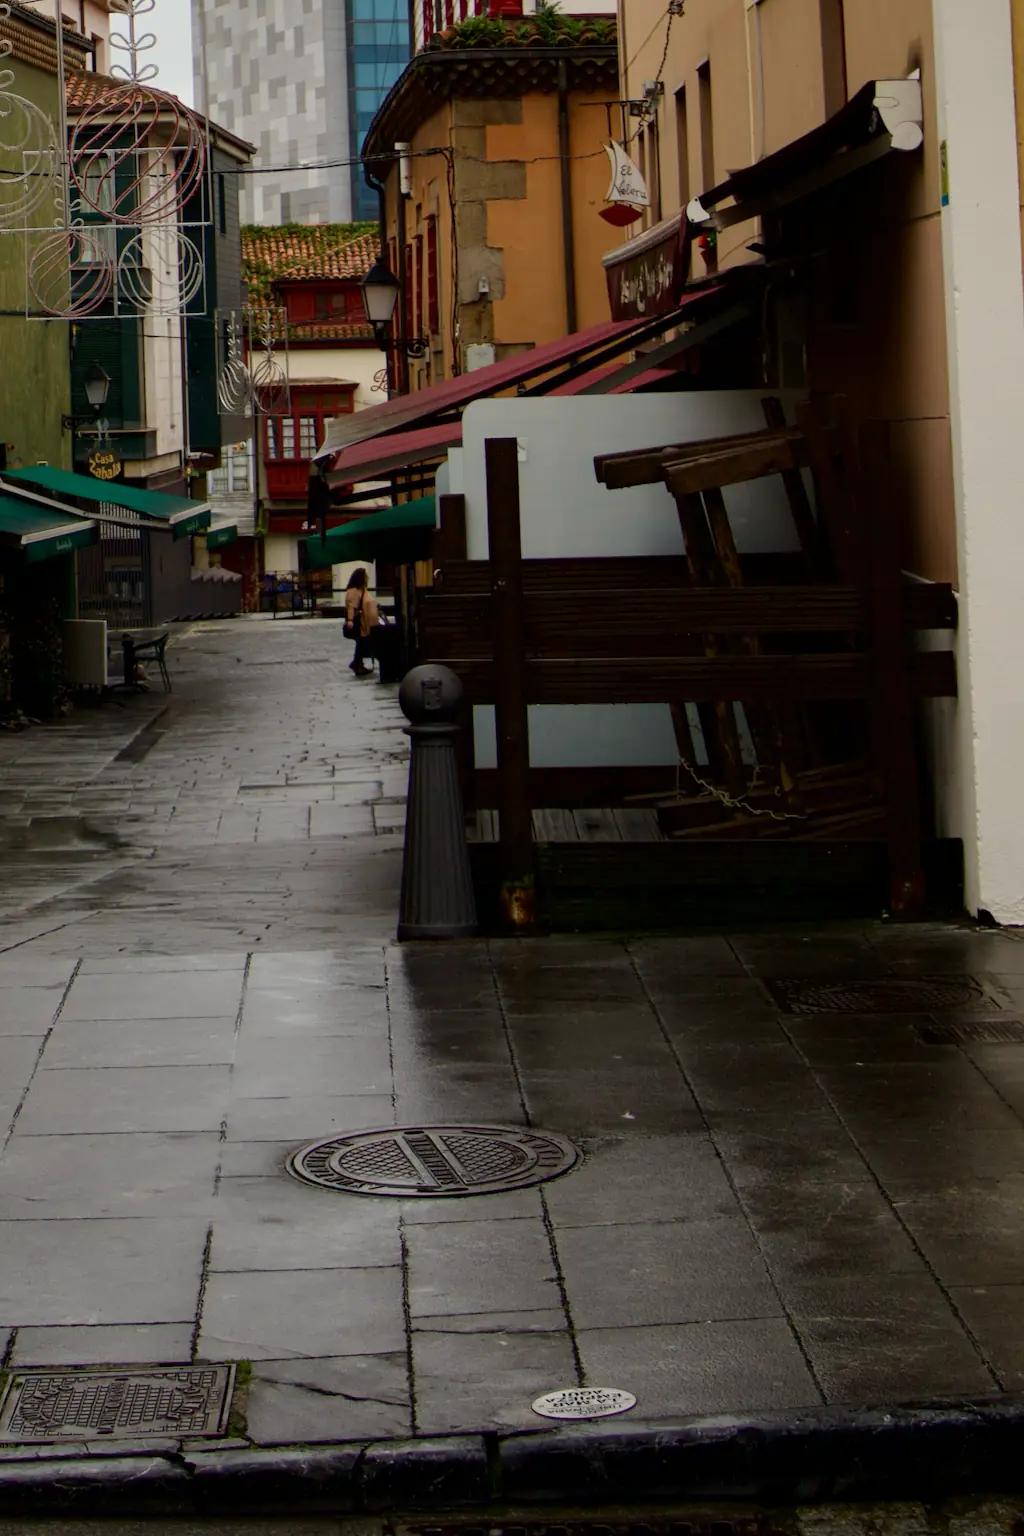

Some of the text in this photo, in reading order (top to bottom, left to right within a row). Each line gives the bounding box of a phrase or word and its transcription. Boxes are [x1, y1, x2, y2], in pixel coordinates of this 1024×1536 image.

[621, 165, 632, 176] El
[95, 452, 114, 465] Casa
[545, 1393, 621, 1403] EMPIEZA
